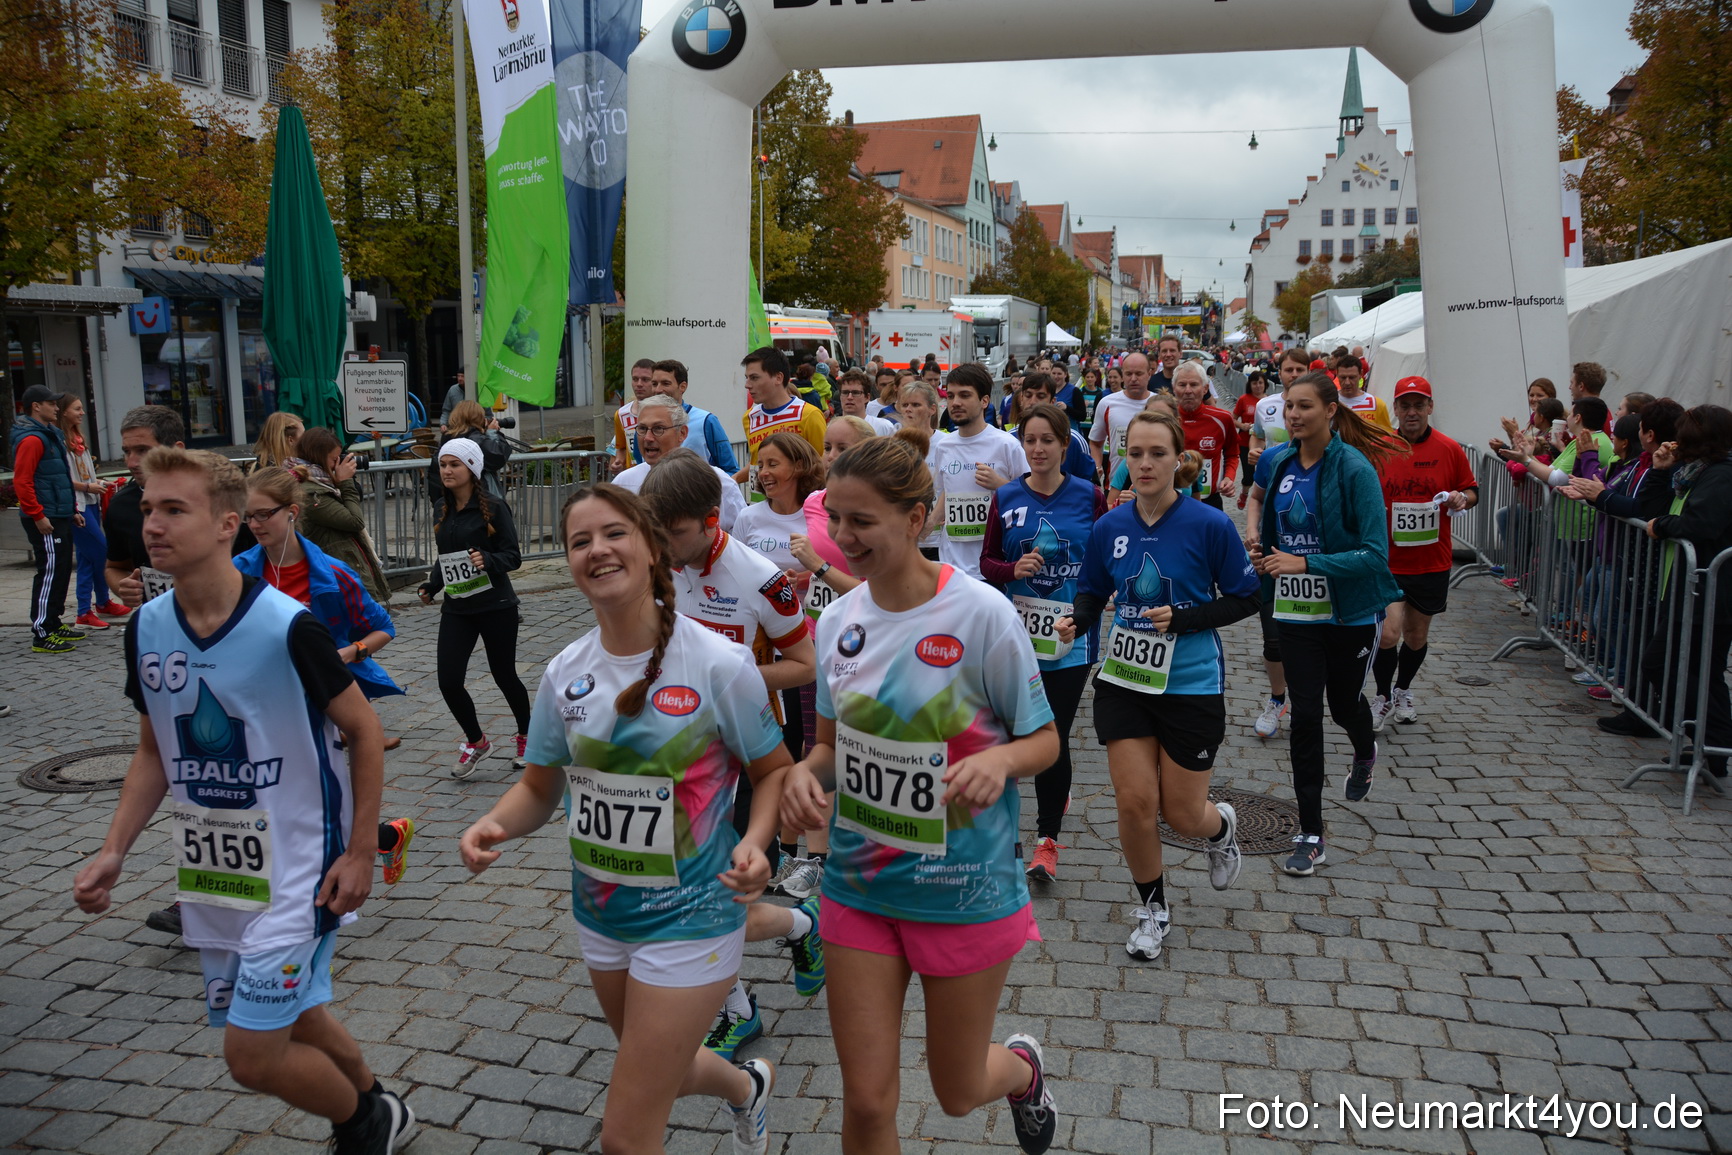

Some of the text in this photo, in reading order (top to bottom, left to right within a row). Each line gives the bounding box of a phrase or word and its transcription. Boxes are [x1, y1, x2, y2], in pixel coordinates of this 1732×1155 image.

[175, 245, 200, 265] City
[1447, 295, 1564, 312] www.bmw-laufsport.de
[627, 317, 726, 329] www.bmw-laufsport.de
[346, 369, 404, 378] Fußgänger Richtung
[749, 432, 769, 446] MAX
[1278, 474, 1296, 494] 6
[949, 504, 987, 522] 5108
[1001, 506, 1028, 528] 11
[1397, 513, 1435, 530] 5311
[954, 527, 981, 535] Frederik
[1113, 535, 1129, 559] 8
[444, 562, 482, 582] 5184
[1280, 577, 1326, 599] 5005
[1292, 603, 1310, 613] Anna
[1017, 609, 1055, 637] 138
[922, 641, 959, 660] Hervis
[1113, 632, 1166, 668] 5030
[140, 650, 188, 694] 66
[1115, 664, 1151, 684] Christina
[658, 691, 695, 709] Hervis
[837, 734, 924, 766] PARTL Neumarkt
[570, 775, 651, 799] PARTL Neumarkt
[845, 753, 935, 813] 5078
[197, 788, 248, 800] BASKETS
[174, 812, 251, 830] PARTL Neumarkt
[577, 793, 662, 847] 5077
[856, 805, 918, 838] Elisabeth
[184, 828, 264, 872] 5159
[590, 848, 645, 872] Barbara
[915, 863, 982, 873] Neumarkter
[195, 874, 256, 897] Alexander
[914, 875, 970, 887] Stadtlauf
